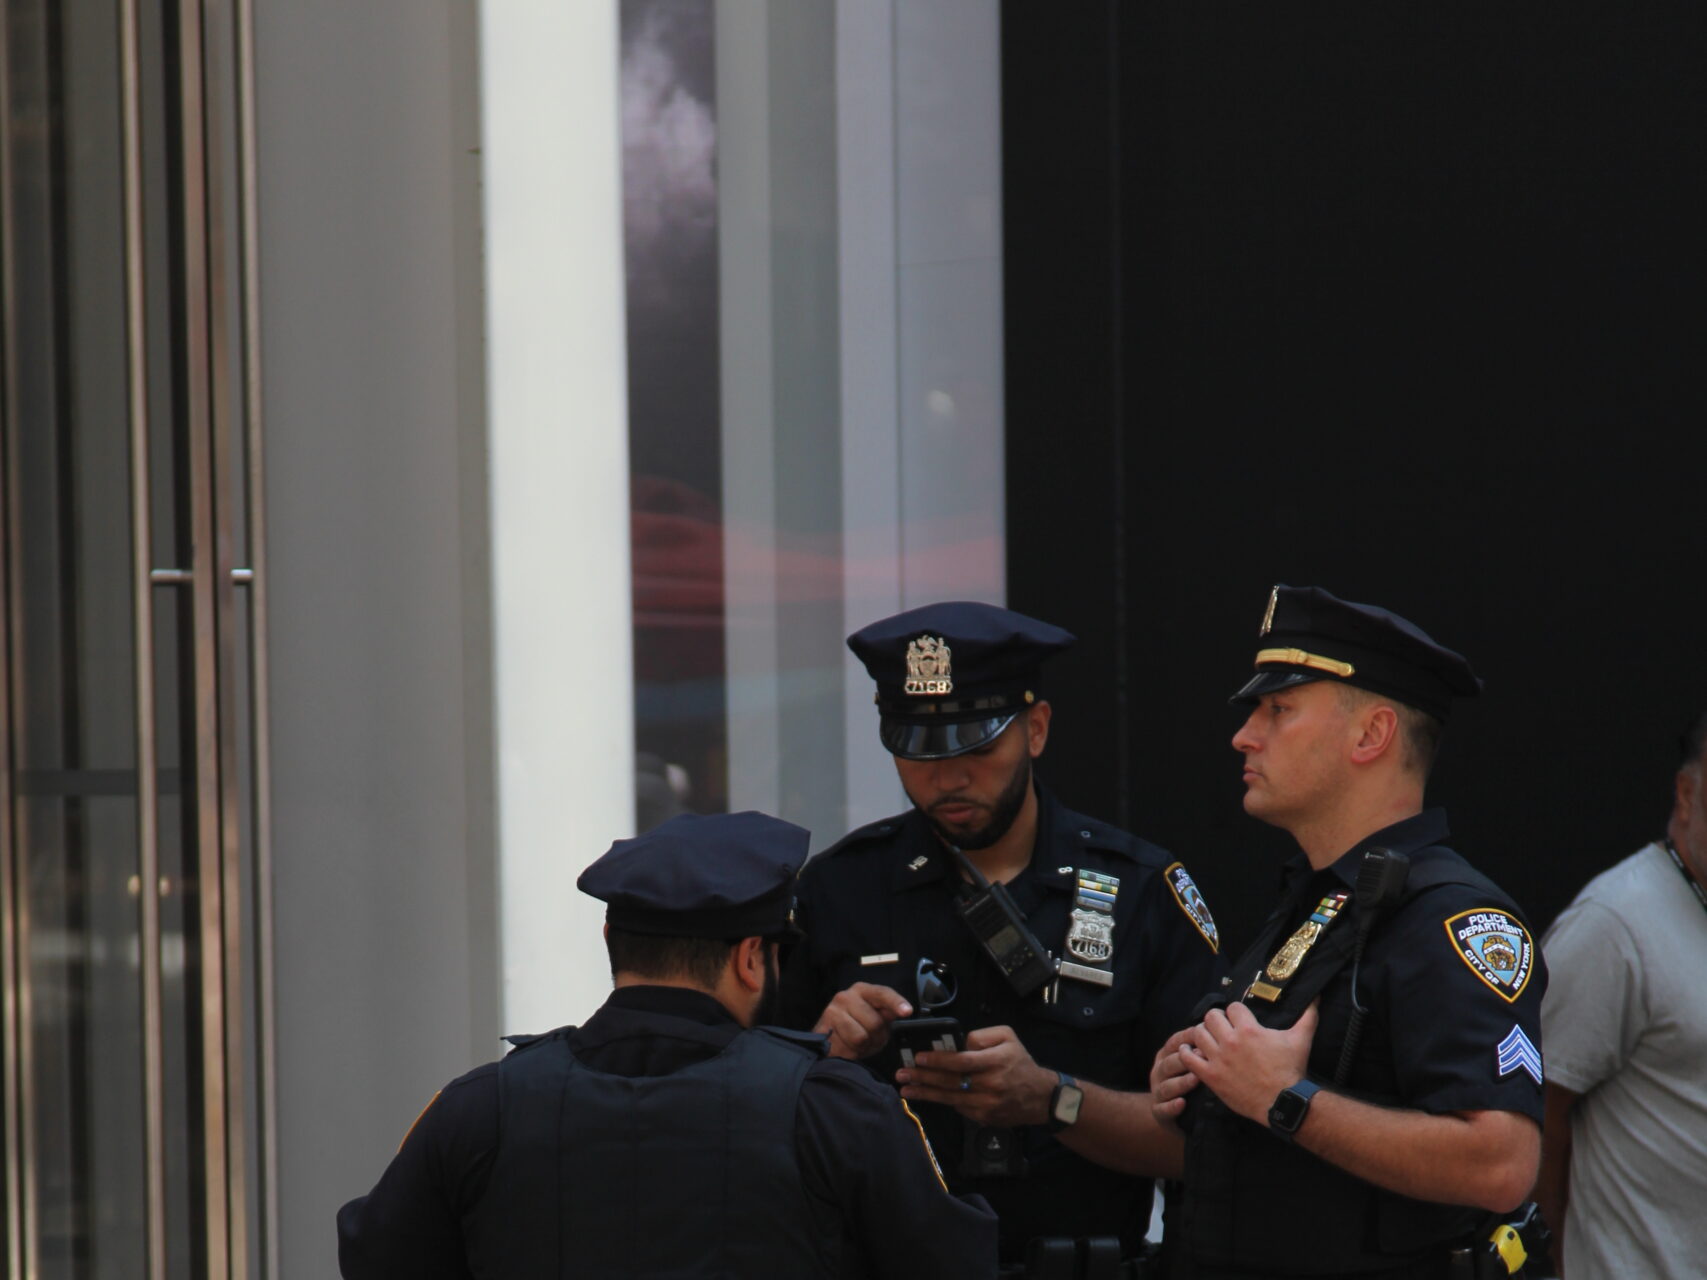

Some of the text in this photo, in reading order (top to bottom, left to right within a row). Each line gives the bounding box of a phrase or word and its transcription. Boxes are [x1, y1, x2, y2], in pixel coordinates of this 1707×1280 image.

[1469, 914, 1507, 925] POLICE
[1458, 922, 1524, 941] DEPARTMENT
[1074, 940, 1106, 957] 7168
[1465, 950, 1500, 985] CITY OF
[1512, 942, 1531, 991] NEW YORK
